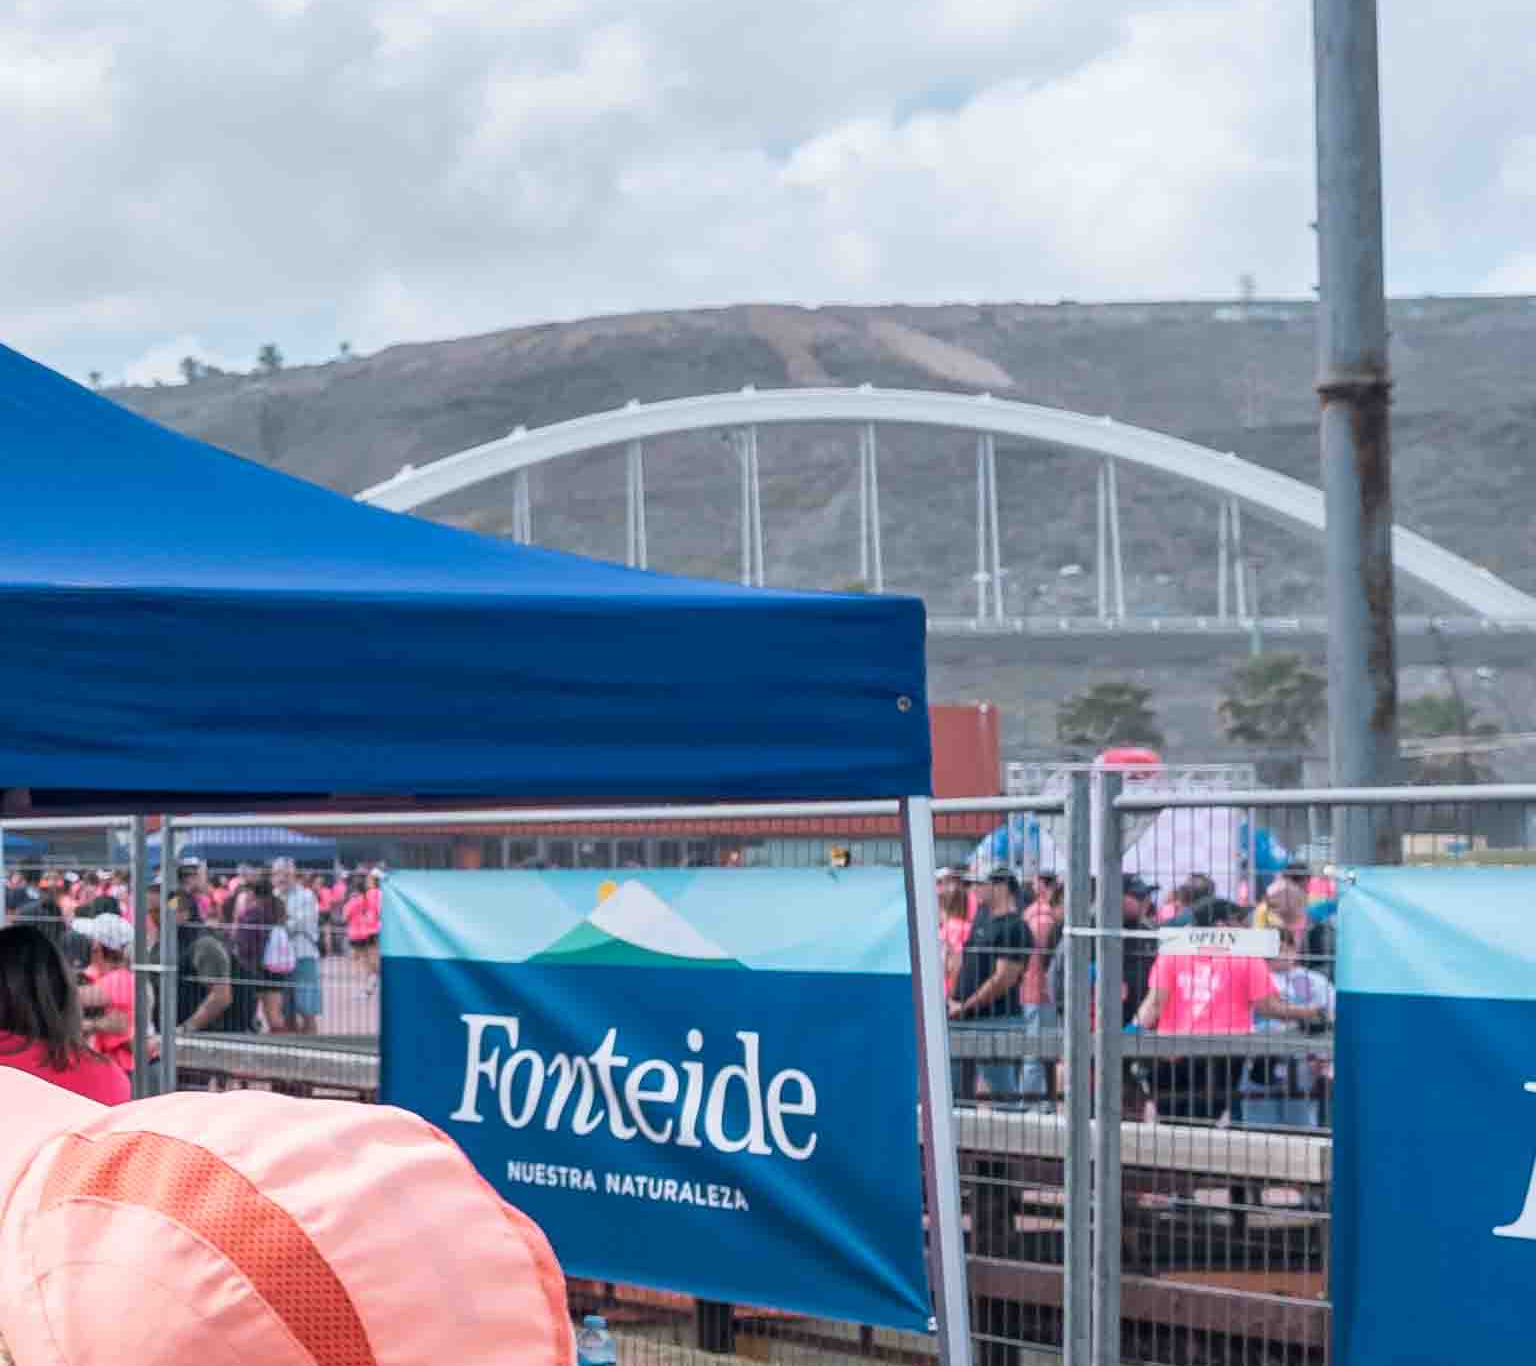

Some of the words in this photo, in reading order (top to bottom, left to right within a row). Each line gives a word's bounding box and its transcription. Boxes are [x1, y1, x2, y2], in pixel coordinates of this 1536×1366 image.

[449, 1012, 818, 1161] Fonteide
[506, 1160, 597, 1192] NUESTRA
[604, 1172, 750, 1212] NATURALEZA
